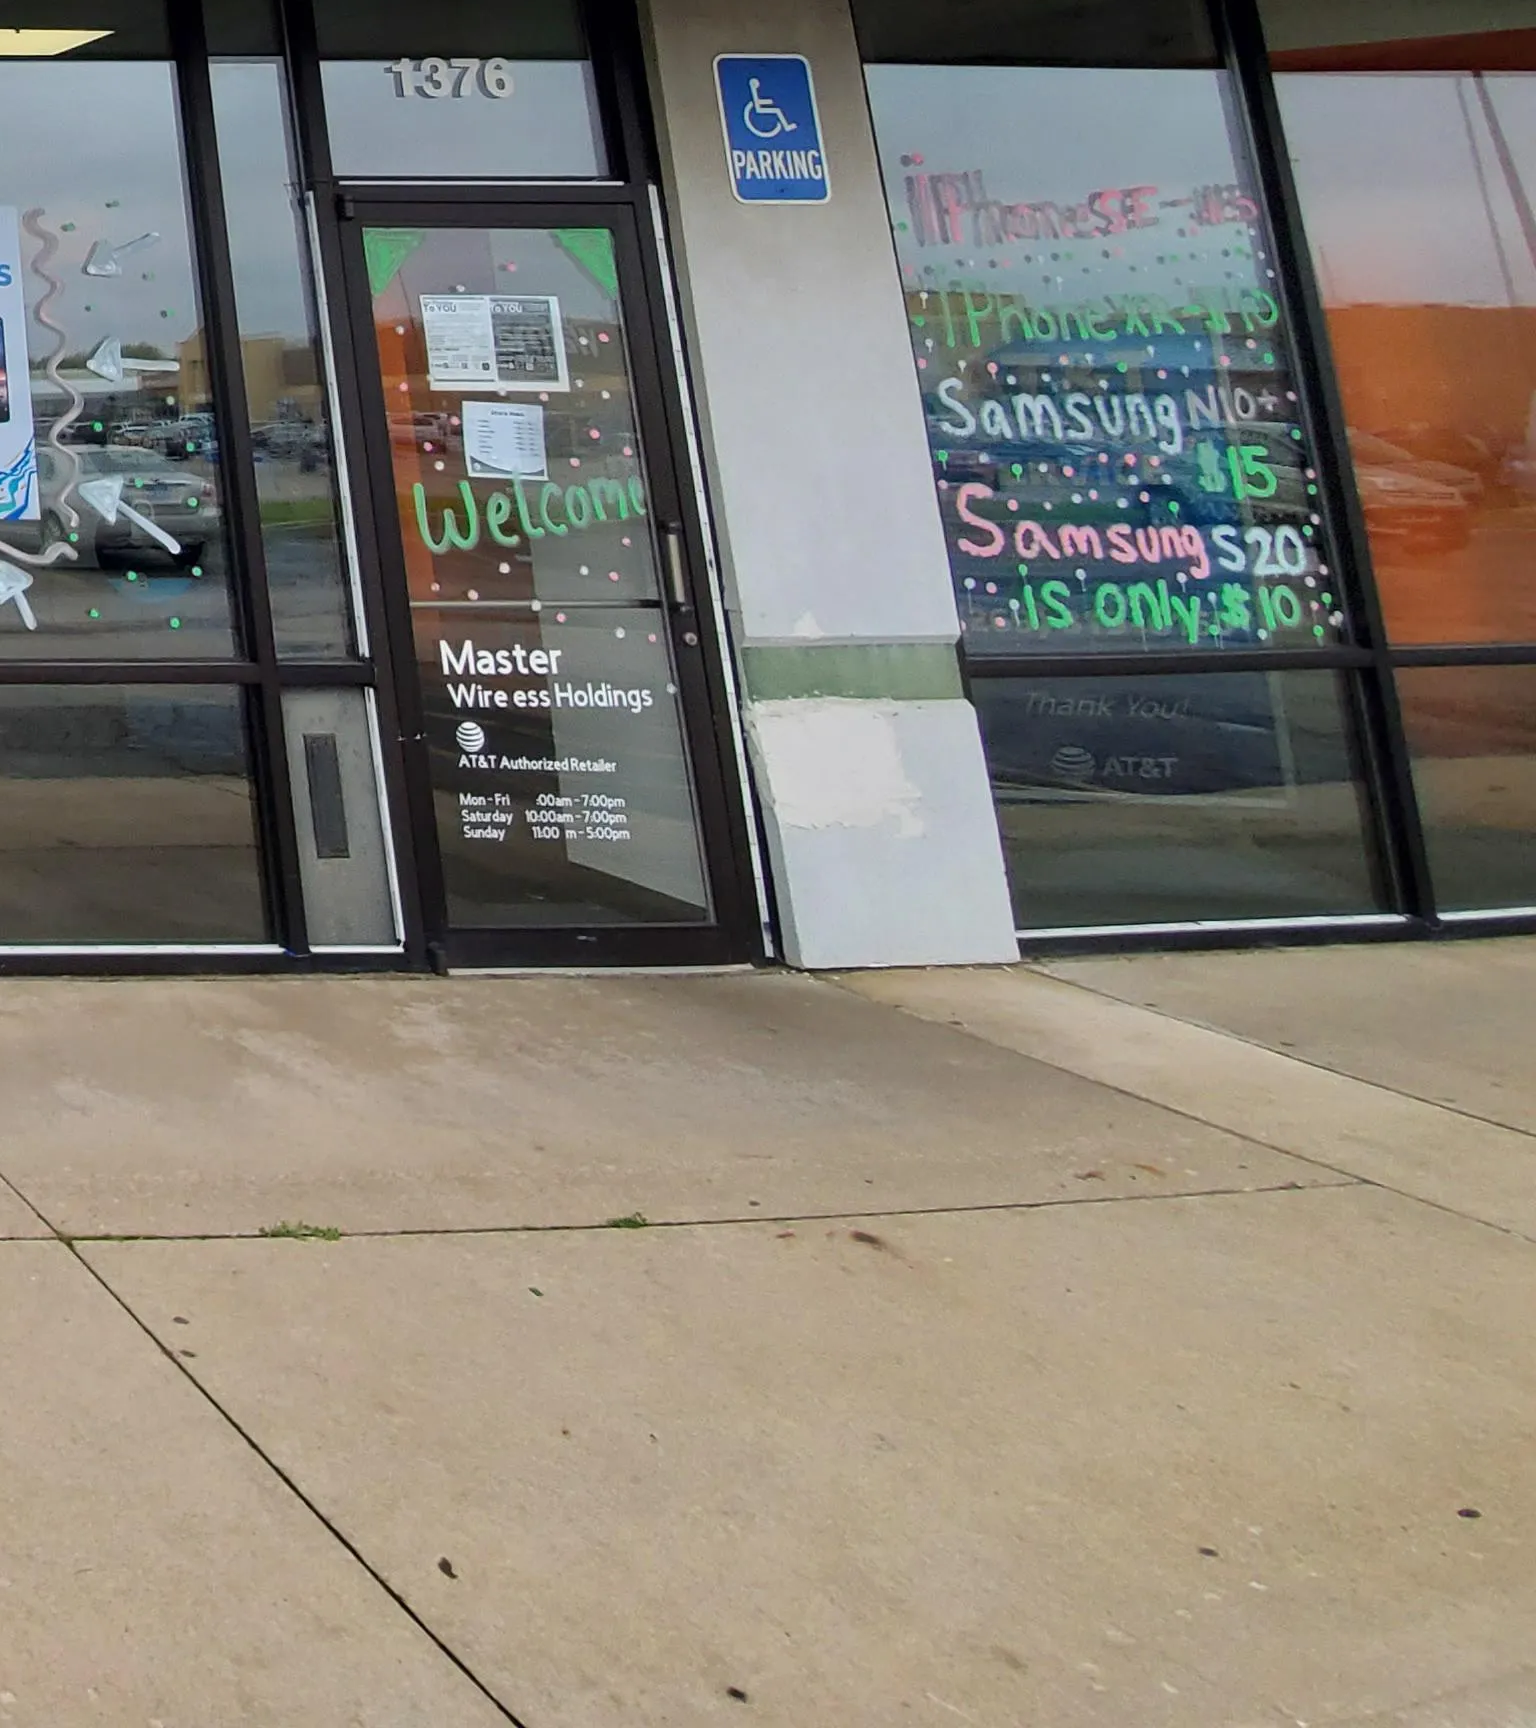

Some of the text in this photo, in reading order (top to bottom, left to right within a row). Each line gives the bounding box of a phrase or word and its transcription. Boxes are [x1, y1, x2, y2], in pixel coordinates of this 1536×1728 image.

[388, 57, 514, 99] 1376
[733, 149, 822, 181] PARKING
[937, 377, 1278, 455] Samsung N10+
[956, 482, 1307, 579] Samsung S20
[1096, 580, 1200, 645] only
[439, 640, 562, 675] Master
[447, 682, 653, 713] Wireess Holdings
[1026, 692, 1191, 722] Thank You!
[458, 755, 617, 773] AT&T Authorized Retailer
[1102, 755, 1179, 779] AT&T
[581, 794, 625, 809] 7:00pm
[461, 810, 513, 825] Saturday
[525, 810, 574, 823] 10:00am
[582, 811, 627, 825] 7:00pm
[463, 826, 506, 842] Sunday
[587, 827, 631, 842] 5:00pm
